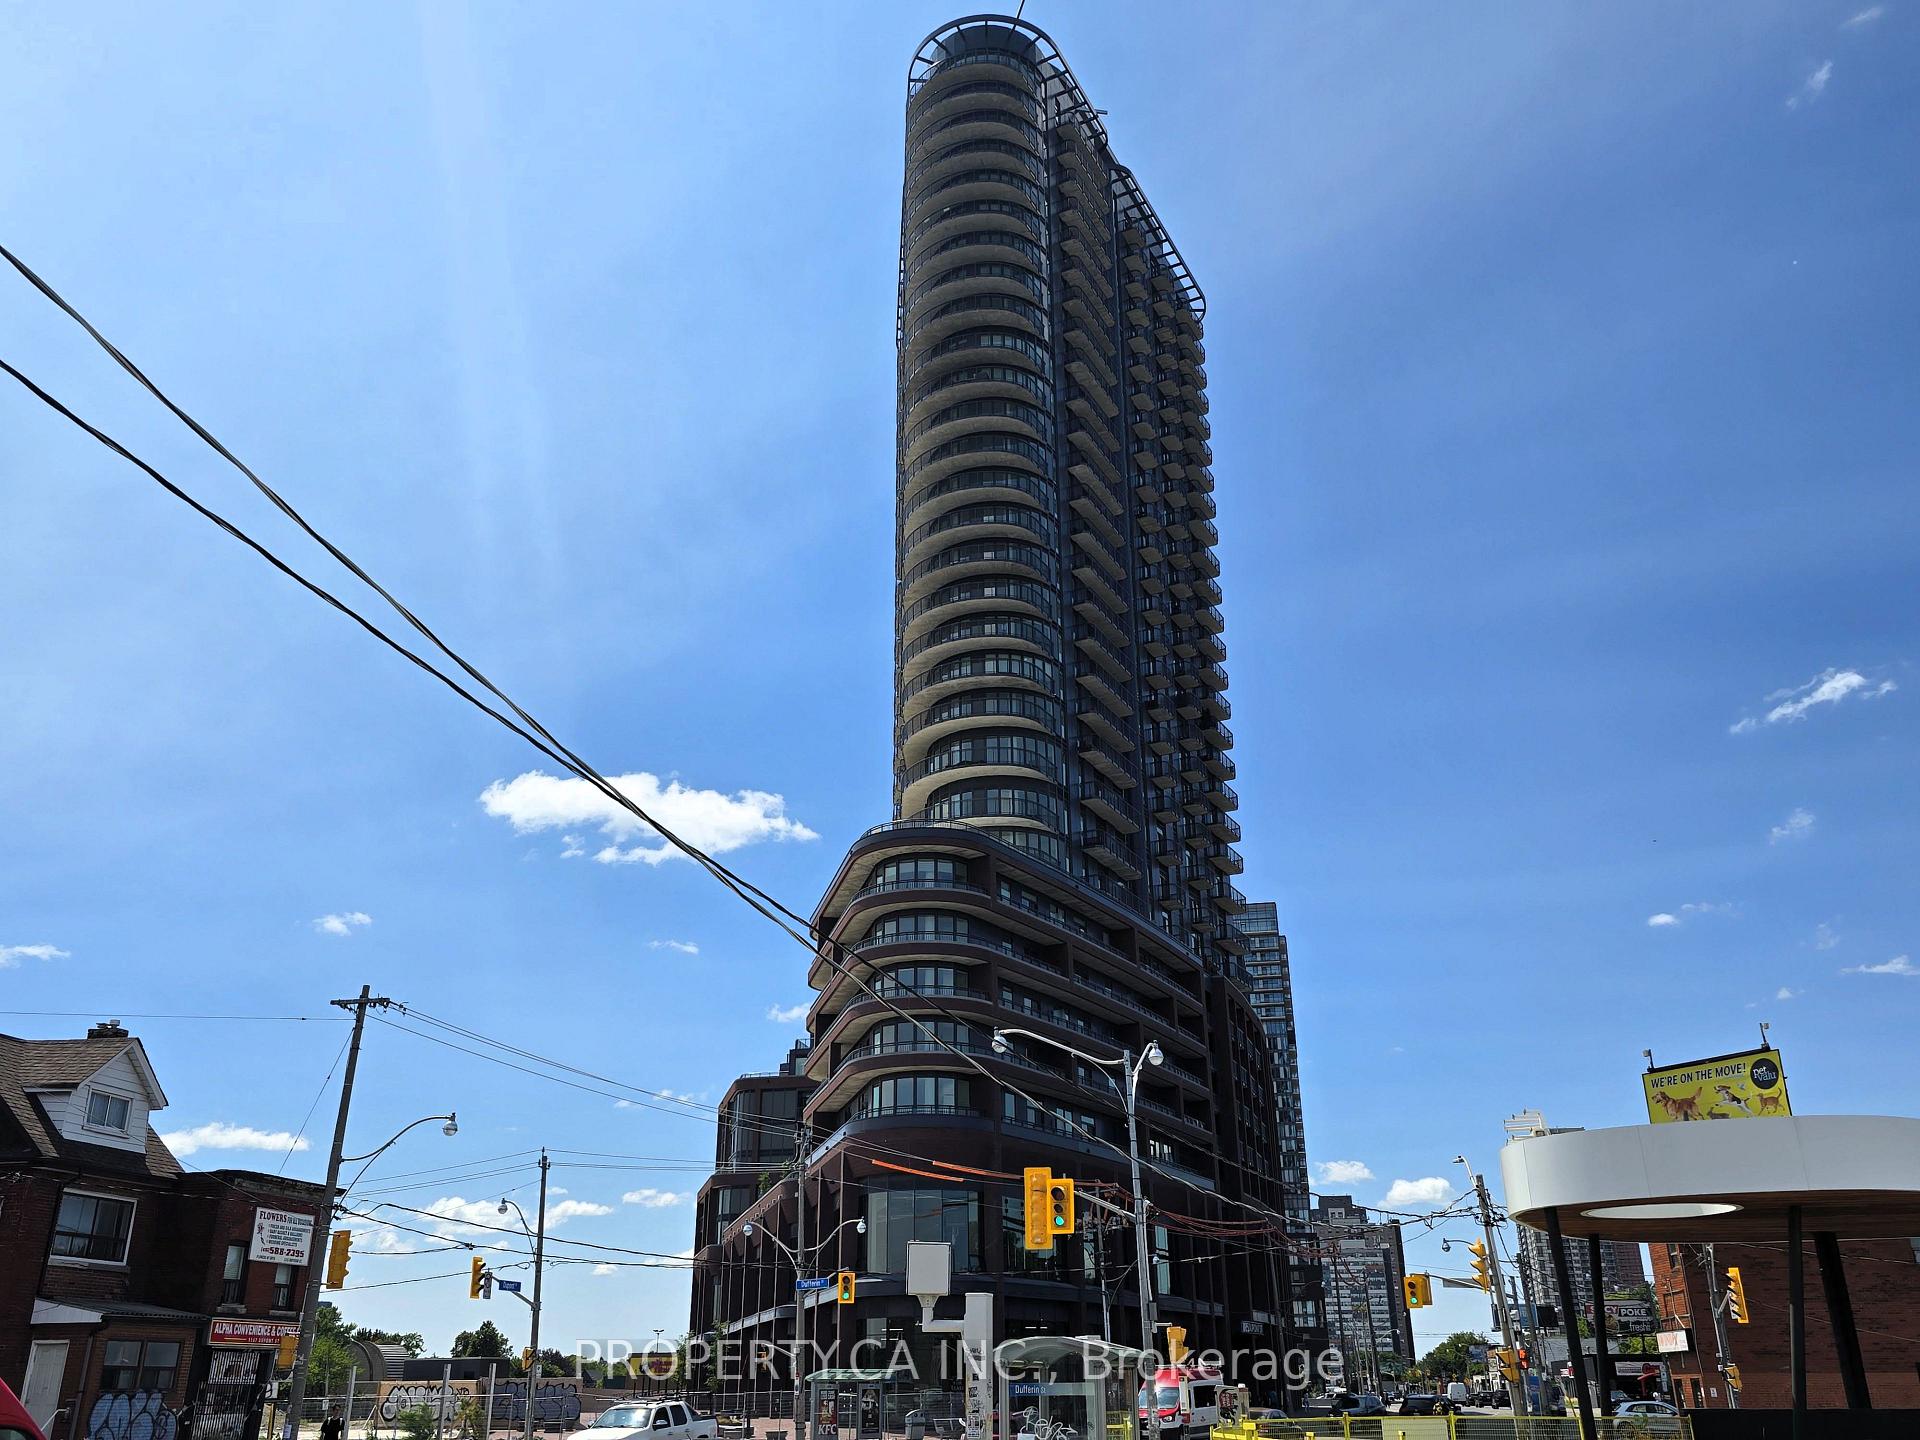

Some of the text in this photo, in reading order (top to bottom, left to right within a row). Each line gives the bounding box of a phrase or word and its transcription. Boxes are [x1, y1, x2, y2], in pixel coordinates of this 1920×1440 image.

[1651, 1062, 1746, 1089] WE'RE ON THE MOVE!
[1752, 1066, 1767, 1079] pet
[1758, 1071, 1777, 1081] valu
[260, 1211, 287, 1223] FLOWERS
[801, 1280, 820, 1288] Dufferin
[1620, 1308, 1647, 1316] POKE
[215, 1323, 233, 1334] ALPHA
[234, 1324, 270, 1336] CONVENIENCE
[270, 1326, 276, 1336] &
[1015, 1384, 1040, 1394] Dufferin
[818, 1424, 837, 1435] KFC
